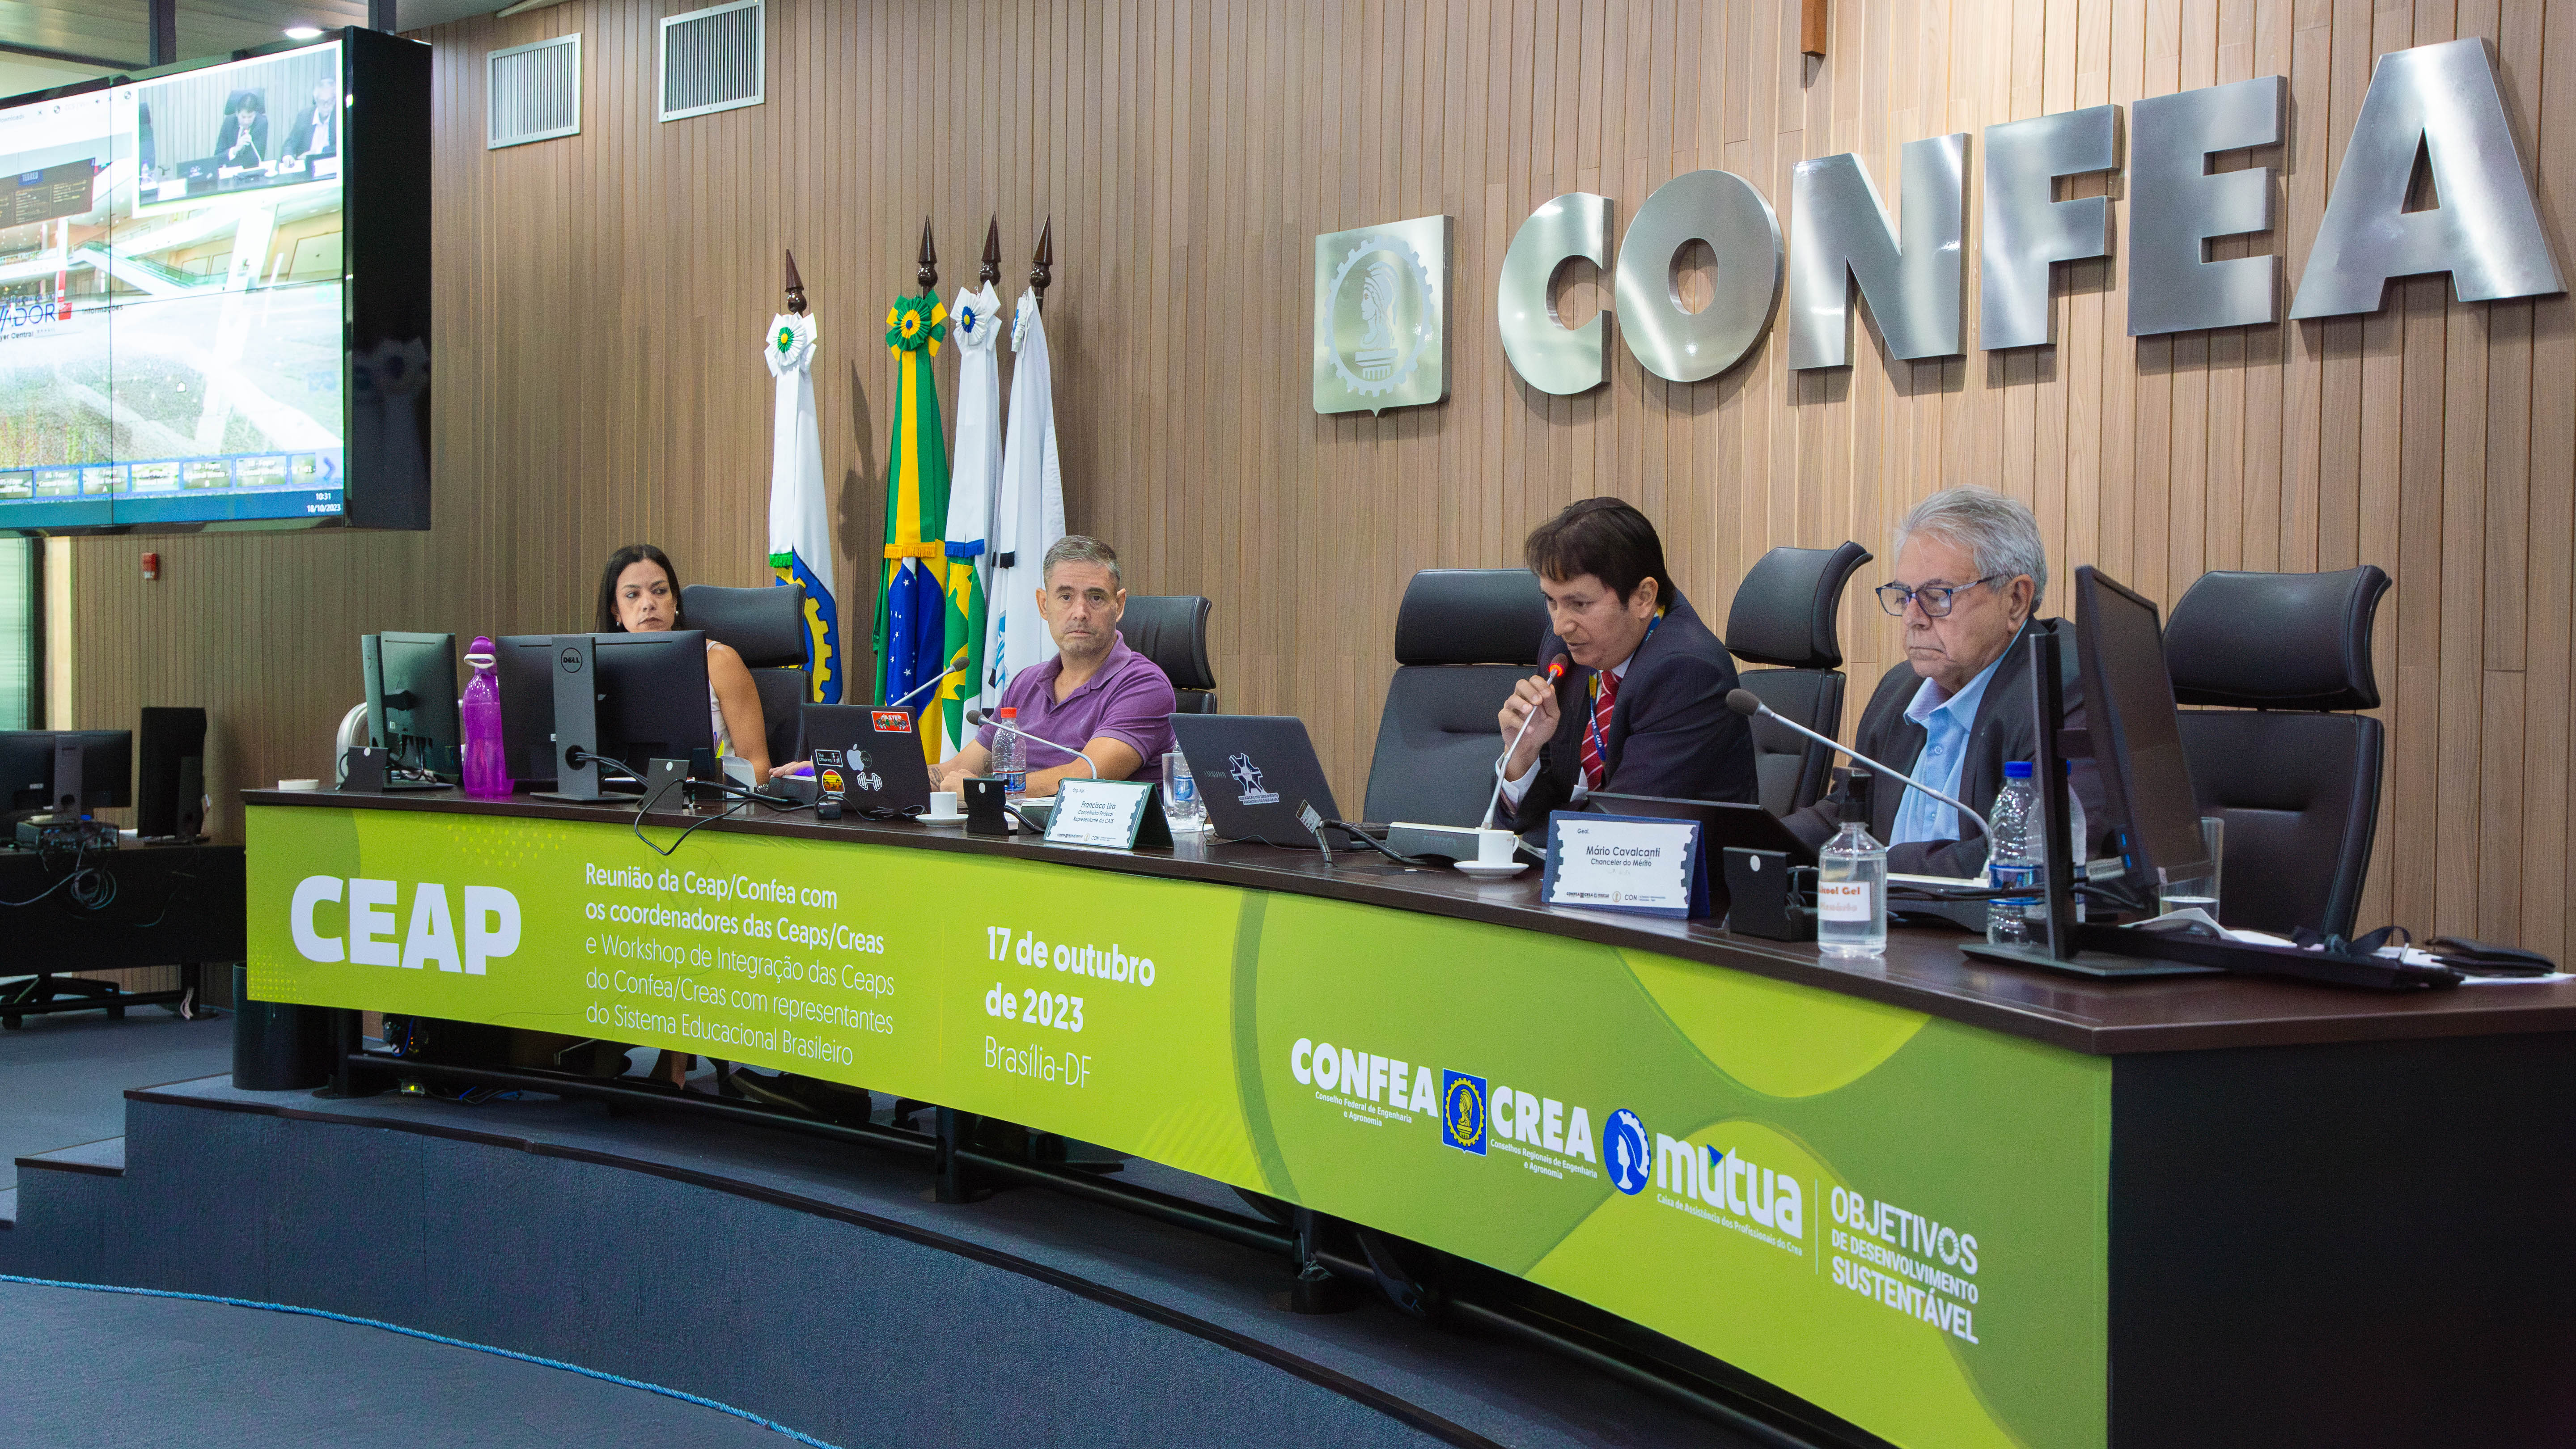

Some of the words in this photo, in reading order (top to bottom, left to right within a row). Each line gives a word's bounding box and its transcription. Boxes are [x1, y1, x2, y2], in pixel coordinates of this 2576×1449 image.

[1498, 37, 2567, 394] CONFEA
[11, 331, 34, 339] Central
[307, 504, 341, 513] 18/10/2023
[315, 492, 331, 500] 10:31
[1081, 801, 1106, 809] Francisco
[1586, 845, 1610, 856] Mário
[1612, 847, 1661, 857] Cavalcanti
[1633, 859, 1652, 867] Mérito
[586, 863, 653, 890] Reunião
[658, 869, 679, 892] da
[684, 871, 796, 904] Ceap/Confea
[801, 887, 837, 909] com
[1842, 886, 1860, 895] Gel
[291, 875, 521, 975] CEAP
[586, 902, 605, 920] os
[610, 904, 738, 934] coordenadores
[743, 913, 772, 939] das
[777, 918, 884, 954] Ceaps/Creas
[586, 937, 596, 953] e
[602, 934, 685, 968] Workshop
[691, 944, 712, 967] de
[718, 950, 803, 983] Integração
[809, 960, 836, 986] das
[842, 964, 894, 998] Ceaps
[987, 926, 1011, 961] 17
[1016, 931, 1048, 968] de
[1054, 944, 1155, 987] outubro
[586, 967, 609, 989] do
[614, 970, 726, 1007] Confea/Creas
[731, 990, 767, 1012] com
[774, 996, 893, 1034] representantes
[986, 982, 1017, 1019] de
[1023, 988, 1083, 1032] 2023
[586, 1002, 609, 1024] do
[615, 1004, 676, 1034] Sistema
[682, 1014, 777, 1051] Educacional
[784, 1030, 853, 1065] Brasileiro
[986, 1035, 1091, 1088] Brasília-DF
[1291, 1038, 1438, 1117] CONFEA
[1316, 1091, 1342, 1105] Conselho
[1344, 1098, 1367, 1111] Federal
[1368, 1104, 1376, 1114] de
[1377, 1107, 1412, 1123] Engenharia
[1349, 1111, 1382, 1127] Agronomia
[1491, 1086, 1597, 1164] CREA
[1491, 1139, 1521, 1155] Conselhos
[1522, 1148, 1552, 1165] Regionais
[1553, 1156, 1561, 1166] de
[1562, 1159, 1597, 1178] Engenharia
[1530, 1162, 1563, 1179] Agronomia
[1657, 1194, 1674, 1207] Caixa
[1675, 1199, 1683, 1210] de
[1684, 1203, 1720, 1224] Assistência
[1721, 1216, 1733, 1229] dos
[1734, 1221, 1775, 1246] Profissionais
[1777, 1237, 1785, 1249] do
[1787, 1241, 1802, 1256] Crea
[1831, 1186, 1978, 1275] OBJETIVOS
[1832, 1229, 1848, 1251] DE
[1851, 1234, 1979, 1305] DESENVOLVIMENTO
[1832, 1257, 1979, 1344] SUSTENTÁVEL
